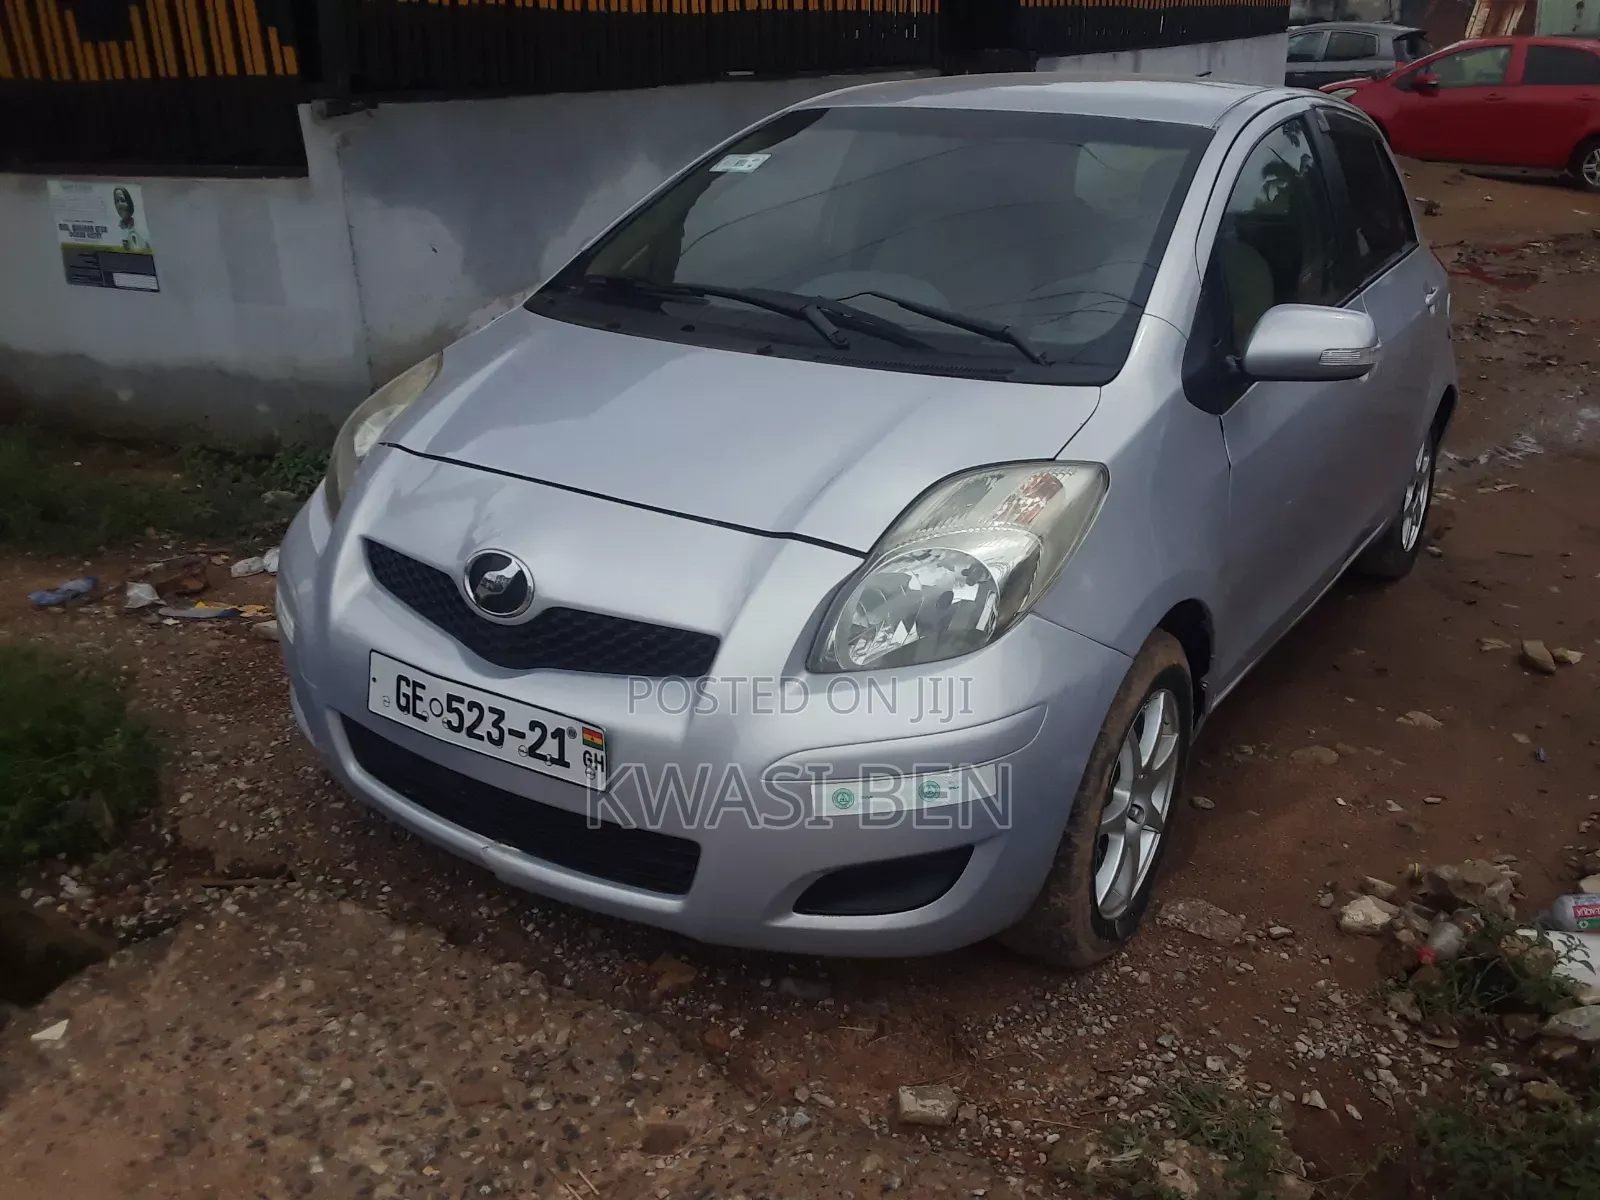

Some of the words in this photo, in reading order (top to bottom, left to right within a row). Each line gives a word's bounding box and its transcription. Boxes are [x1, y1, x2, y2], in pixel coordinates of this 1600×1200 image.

[396, 674, 429, 722] GE
[446, 693, 571, 769] 523-21
[582, 750, 605, 773] GH
